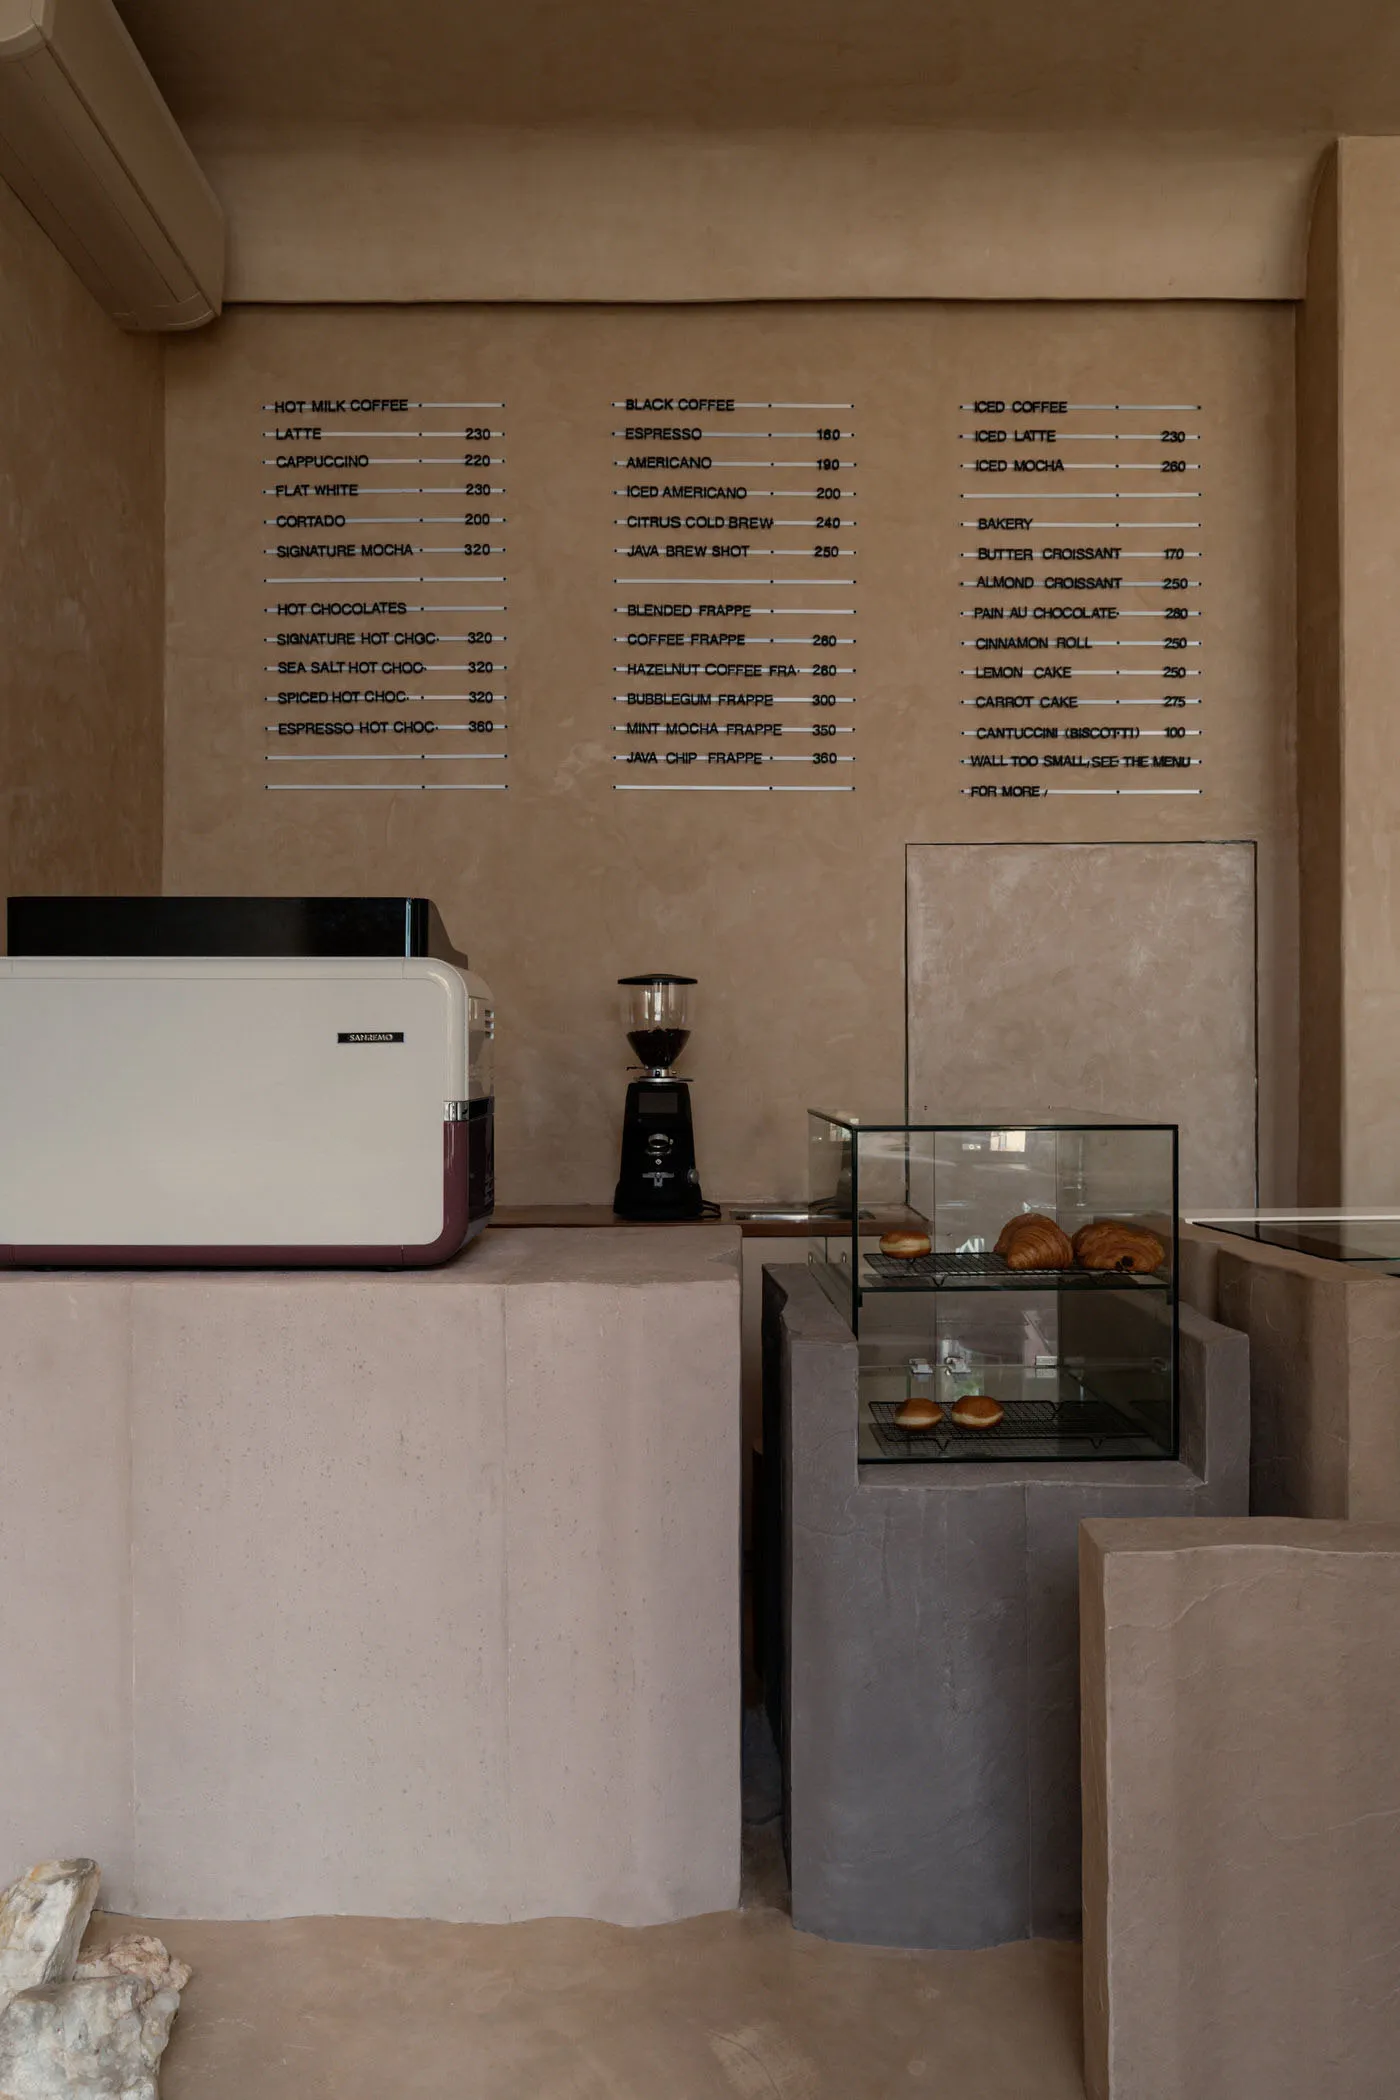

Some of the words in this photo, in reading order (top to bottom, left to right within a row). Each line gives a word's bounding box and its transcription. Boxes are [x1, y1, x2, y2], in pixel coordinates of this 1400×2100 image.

[275, 401, 306, 413] HOT
[312, 400, 345, 412] MILK
[350, 399, 408, 412] COFFEE
[626, 398, 673, 411] BLACK
[678, 399, 734, 411] COFFEE
[974, 401, 1005, 413] ICED
[1012, 401, 1067, 413] COFFEE
[276, 428, 321, 440] LATTE
[466, 428, 490, 440] 230
[625, 427, 701, 440] ESPRESSO
[975, 430, 1006, 443] ICED
[1015, 430, 1056, 442] LATTE
[1161, 431, 1185, 443] 230
[277, 455, 368, 468] CAPPUCCINO
[465, 454, 490, 467] 220
[626, 456, 712, 469] AMERICANO
[817, 459, 839, 470] 190
[976, 460, 1007, 472] ICED
[1014, 459, 1064, 472] MOCHA
[276, 484, 309, 497] FLAT
[314, 484, 358, 496] WHITE
[466, 484, 490, 495] 230
[627, 485, 658, 498] ICED
[662, 486, 747, 499] AMERICANO
[816, 488, 840, 499] 200
[277, 515, 345, 528] CORTADO
[465, 513, 489, 525] 200
[627, 516, 681, 528] CITRUS
[686, 516, 724, 528] COLD
[729, 516, 773, 529] BREW
[816, 517, 840, 529] 240
[978, 518, 1032, 530] BAKERY
[277, 545, 355, 558] SIGNATURE
[362, 544, 413, 556] MOCHA
[465, 544, 490, 556] 320
[627, 545, 659, 557] JAVA
[666, 545, 707, 557] BREW
[712, 545, 749, 557] SHOT
[814, 546, 838, 558] 250
[978, 548, 1033, 560] BUTTER
[1043, 548, 1121, 560] CROISSANT
[1164, 548, 1184, 560] 170
[977, 576, 1034, 589] ALMOND
[1044, 577, 1122, 589] CROISSANT
[1163, 578, 1188, 589] 250
[278, 603, 307, 616] HOT
[311, 602, 406, 615] CHOCOLATES
[628, 604, 692, 617] BLENDED
[699, 605, 751, 617] FRAPPE
[974, 607, 1003, 619] PAIN
[1009, 607, 1027, 618] AU
[1033, 607, 1117, 619] CHOCOLATE
[277, 633, 355, 646] SIGNATURE
[361, 632, 389, 645] HOT
[468, 632, 492, 644] 320
[628, 633, 684, 646] COFFEE
[691, 634, 745, 645] FRAPPE
[976, 637, 1048, 650] CINNAMON
[1057, 637, 1092, 649] ROLL
[1164, 637, 1187, 649] 250
[278, 662, 306, 674] SEA
[311, 661, 345, 674] SALT
[349, 662, 378, 674] HOT
[468, 661, 493, 673] 320
[628, 663, 700, 676] HAZELNUT
[705, 663, 762, 677] COFFEE
[976, 667, 1023, 679] LEMON
[1034, 666, 1071, 679] CAKE
[1163, 667, 1186, 678] 250
[278, 692, 328, 704] SPICED
[332, 691, 360, 703] HOT
[469, 691, 493, 703] 320
[628, 693, 711, 706] BUBBLEGUM
[719, 694, 773, 706] FRAPPE
[812, 695, 835, 706] 300
[976, 696, 1033, 708] CARROT
[1040, 696, 1078, 708] CAKE
[1163, 696, 1185, 707] 275
[279, 722, 354, 735] ESPRESSO
[360, 721, 388, 734] HOT
[627, 722, 660, 734] MINT
[666, 723, 718, 735] MOCHA
[727, 724, 782, 736] FRAPPE
[812, 724, 836, 736] 350
[977, 727, 1058, 739] CANTUCCINI
[1065, 727, 1139, 739] (BISCOTTI)
[1165, 727, 1185, 738] 100
[627, 752, 658, 763] JAVA
[666, 752, 697, 764] CHIP
[708, 752, 762, 765] FRAPPE
[971, 755, 1007, 767] WALL
[1011, 756, 1038, 767] TOO
[1123, 756, 1149, 768] THE
[1152, 756, 1190, 768] MENU
[971, 786, 997, 797] FOR
